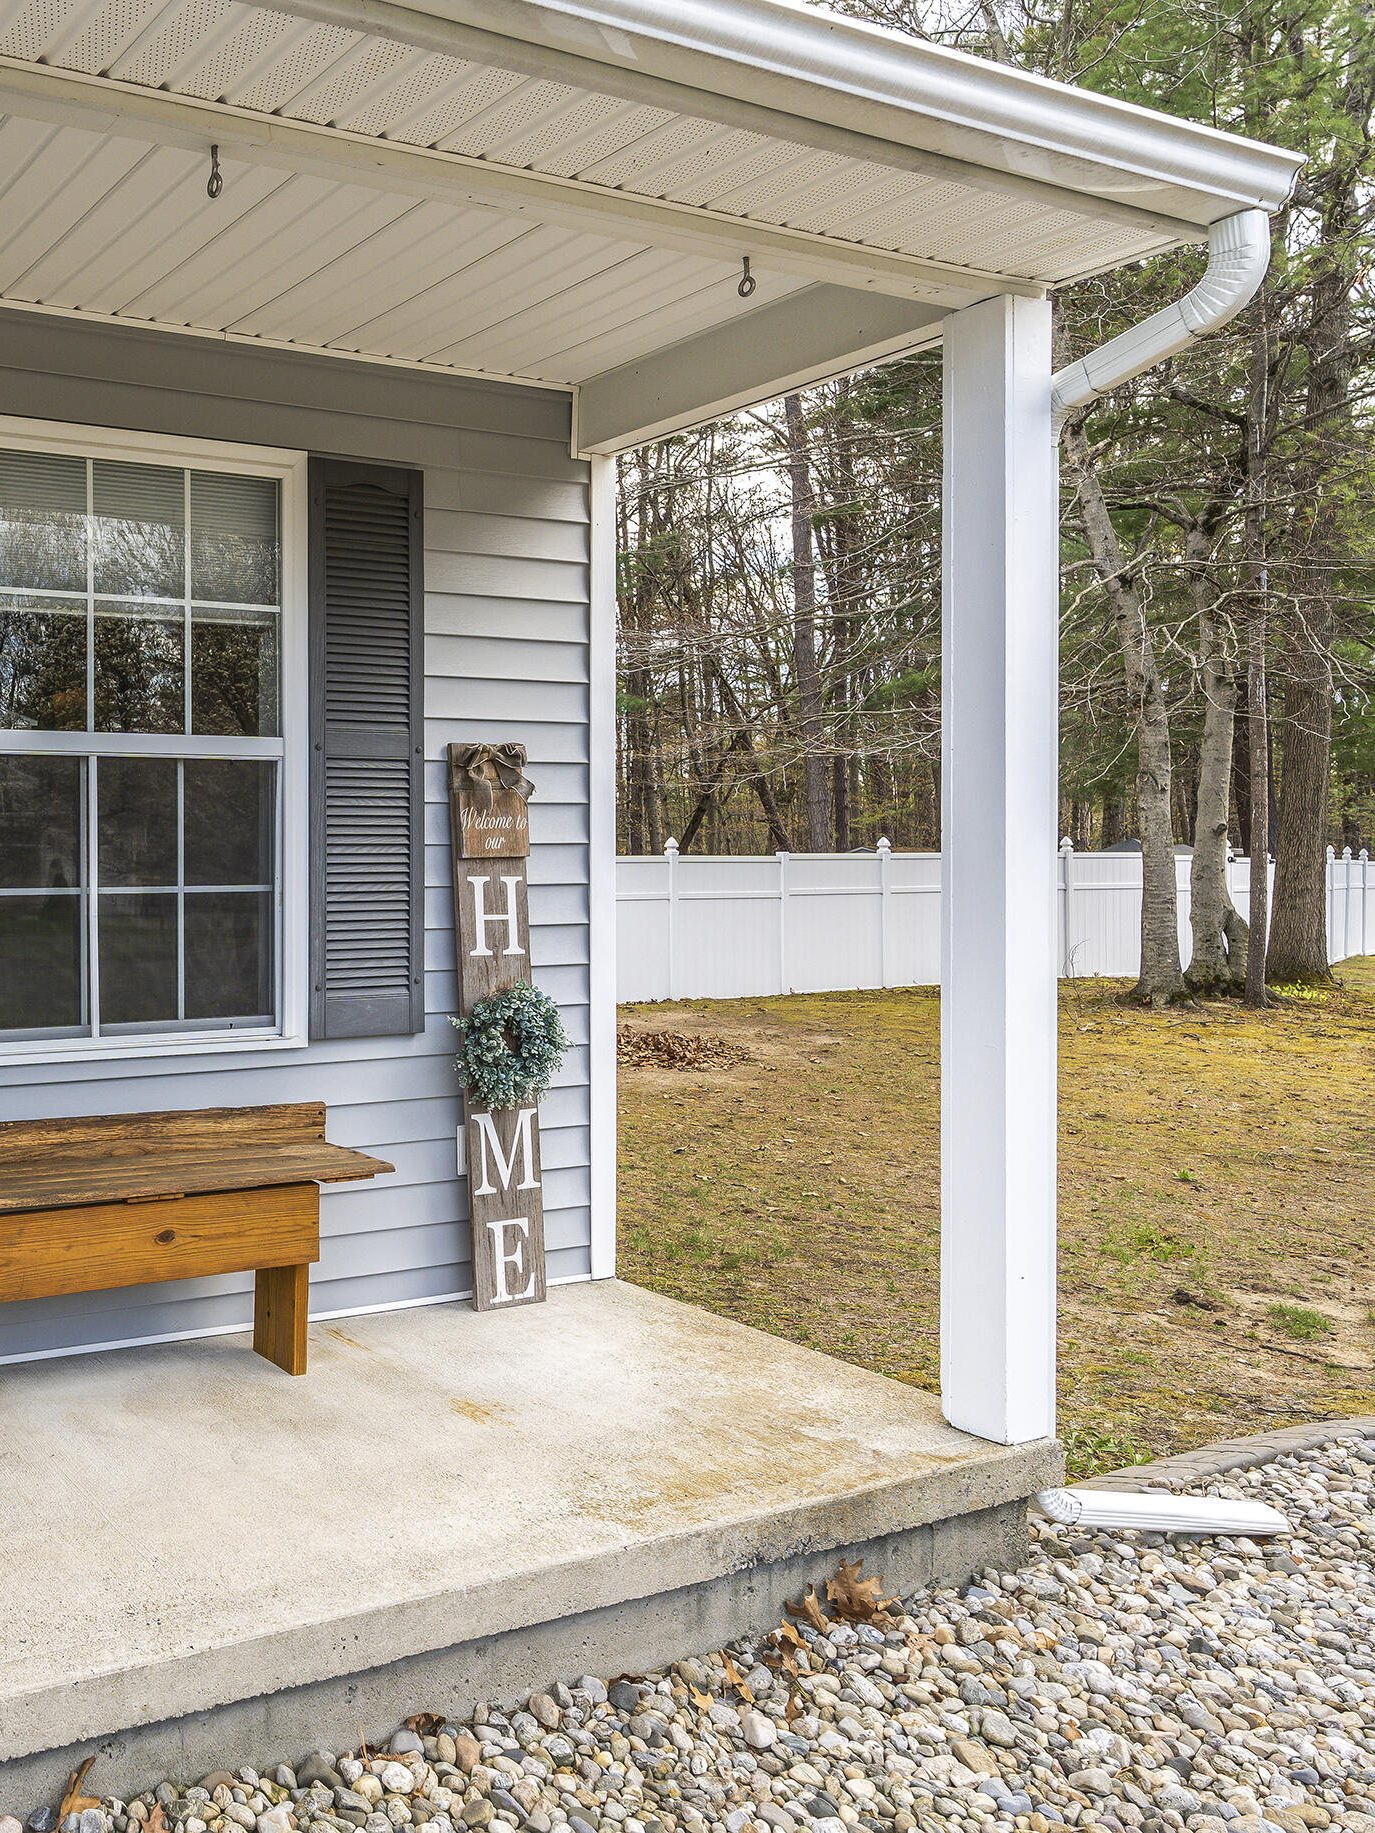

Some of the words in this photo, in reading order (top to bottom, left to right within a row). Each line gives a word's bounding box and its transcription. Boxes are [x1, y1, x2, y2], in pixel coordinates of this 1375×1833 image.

[460, 806, 513, 830] Welcome
[516, 814, 527, 830] to
[485, 836, 506, 850] our
[466, 875, 542, 1304] HME
